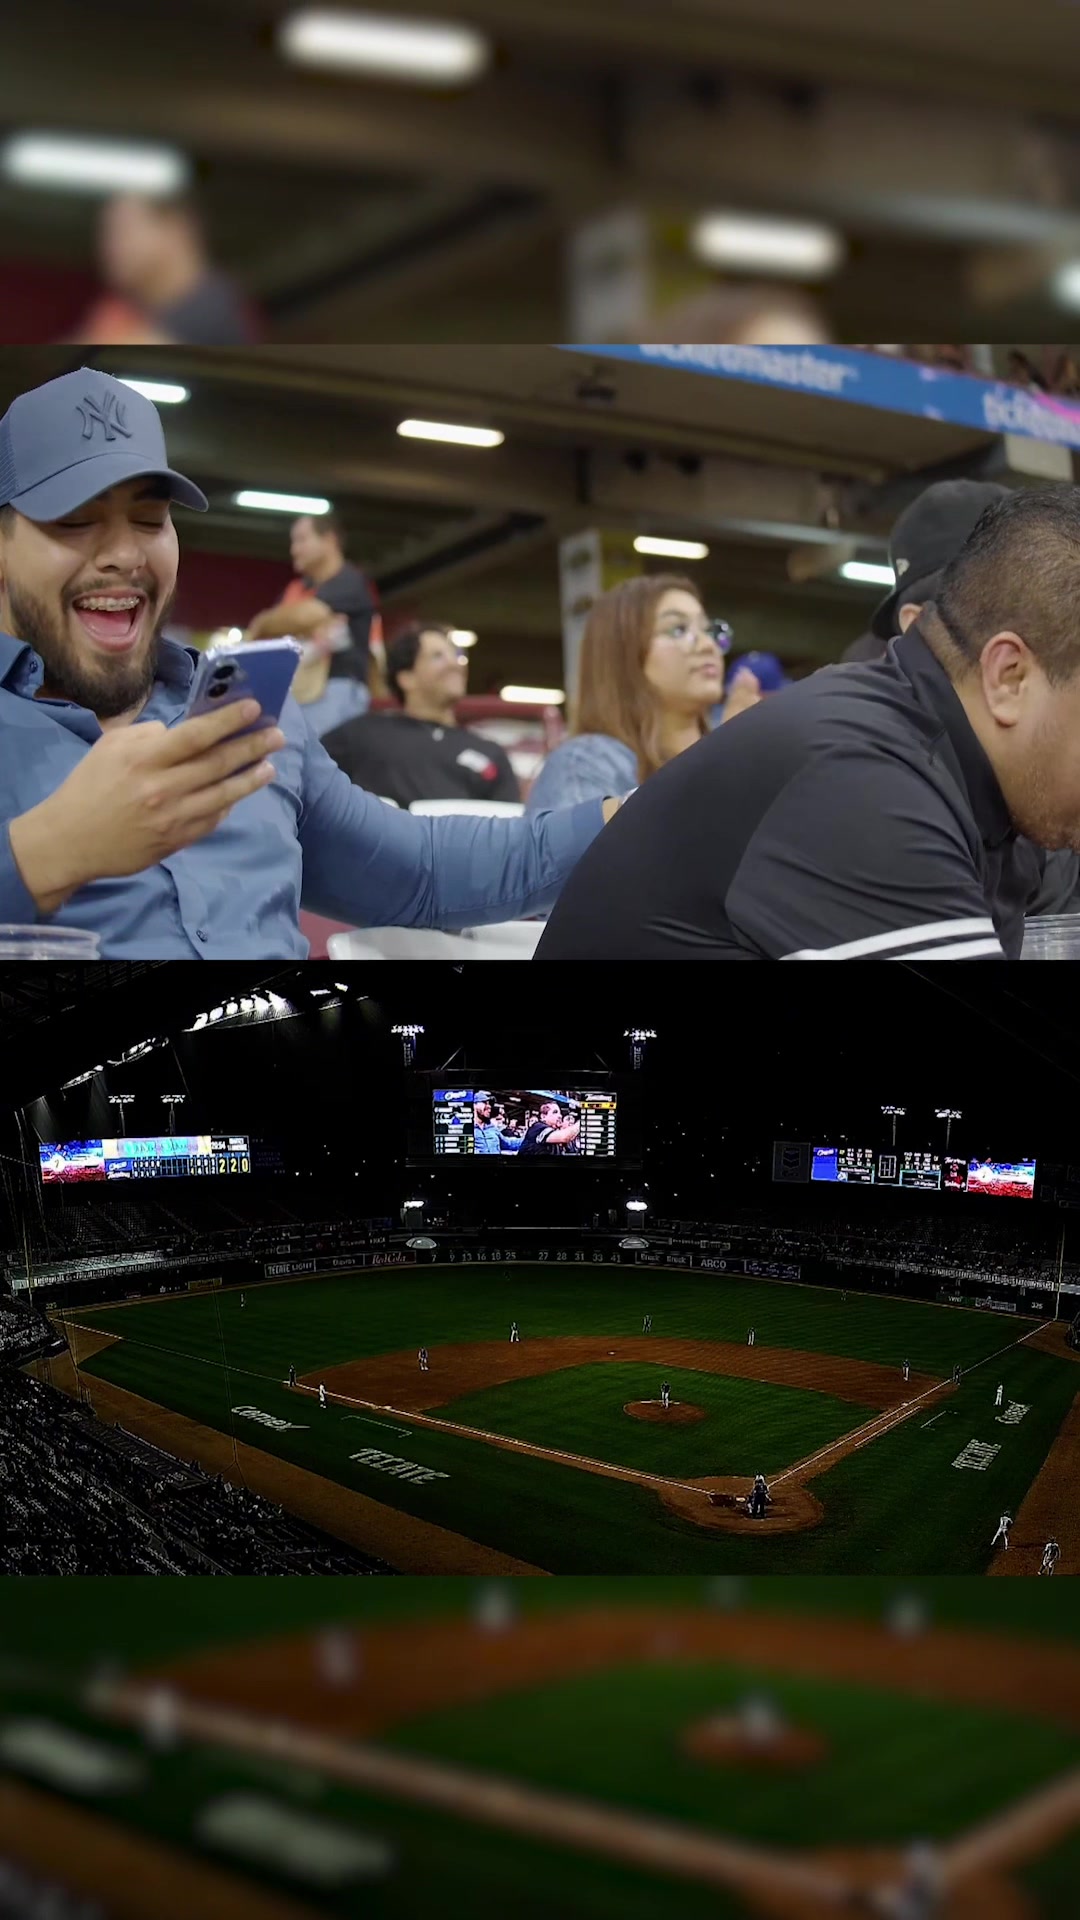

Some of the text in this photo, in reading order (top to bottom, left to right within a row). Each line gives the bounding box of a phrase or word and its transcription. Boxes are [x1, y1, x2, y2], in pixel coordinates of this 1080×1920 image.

[75, 390, 133, 442] NY
[219, 1158, 226, 1173] 2
[230, 1158, 238, 1173] 2
[241, 1158, 249, 1172] 0
[505, 1252, 517, 1260] 25
[538, 1252, 549, 1261] 27
[556, 1252, 567, 1261] 28
[574, 1252, 585, 1262] 31
[610, 1253, 622, 1263] 41
[700, 1258, 727, 1269] ARCO
[267, 1263, 291, 1275] TECATE
[348, 1447, 451, 1485] TECATE
